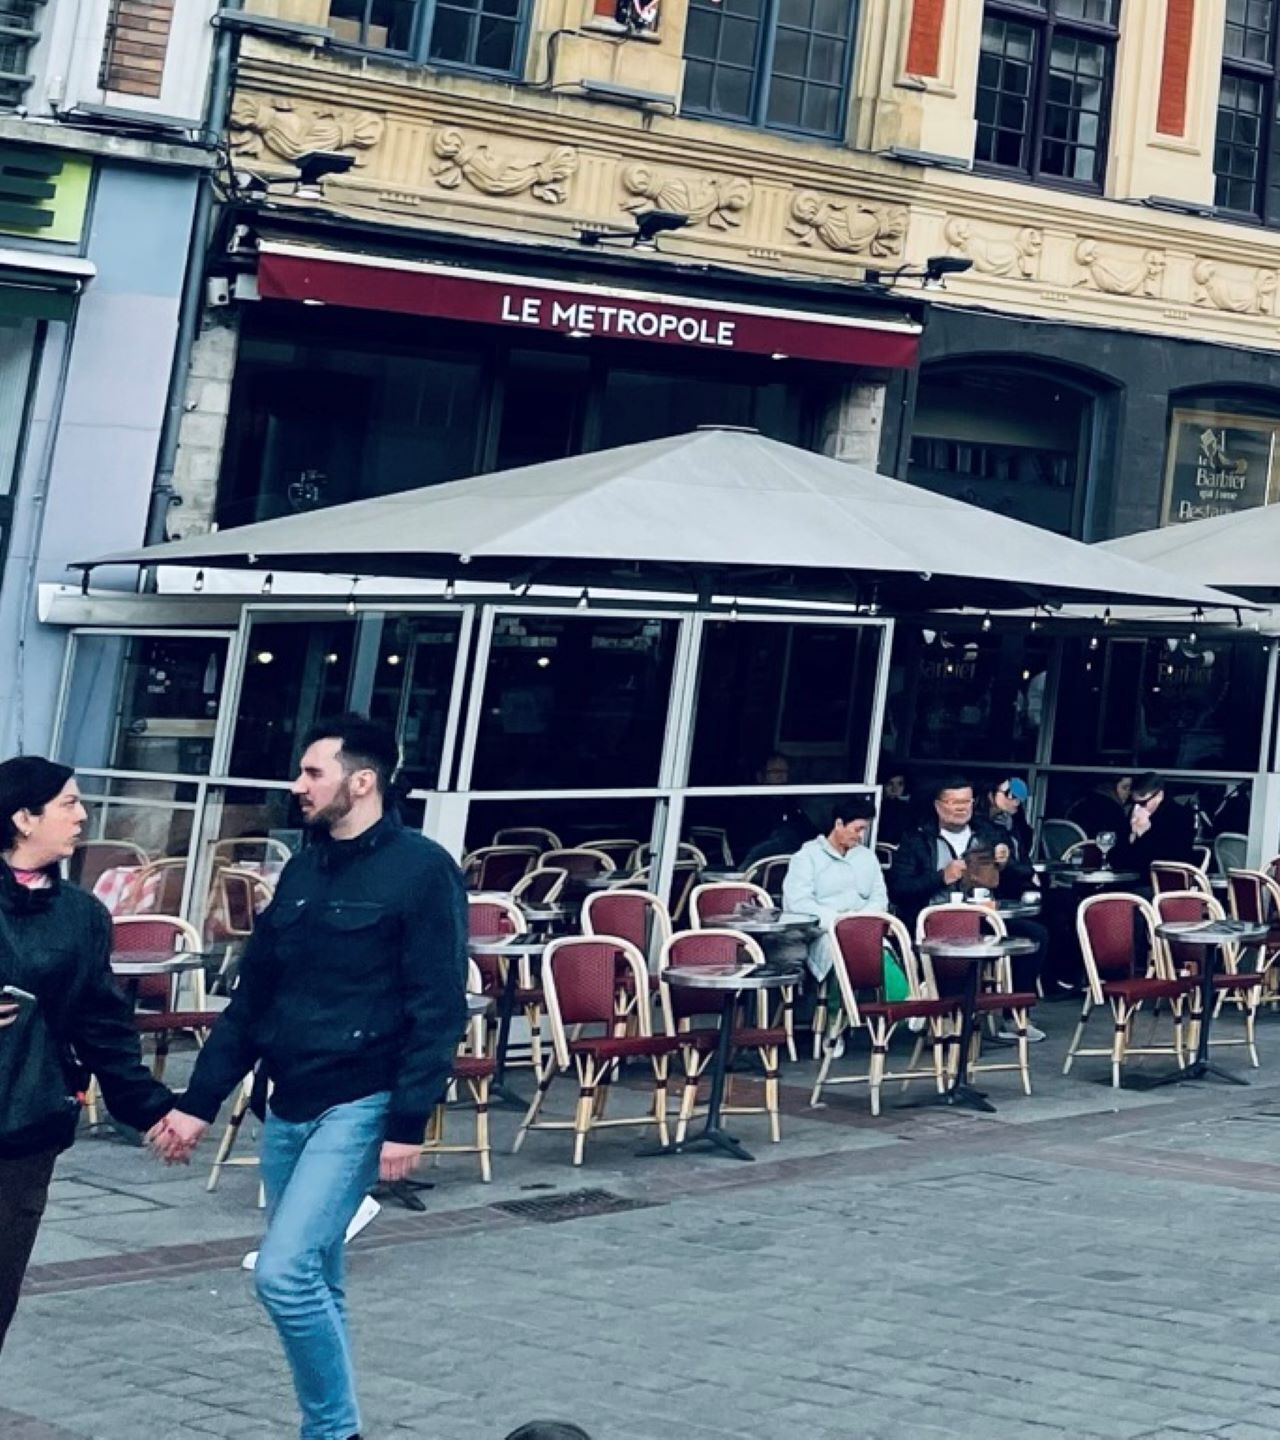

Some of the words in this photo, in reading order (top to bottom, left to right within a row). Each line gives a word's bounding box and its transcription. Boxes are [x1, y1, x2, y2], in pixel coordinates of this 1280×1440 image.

[501, 295, 542, 324] LE
[551, 301, 736, 346] METROPOLE
[1196, 467, 1246, 490] Barbier
